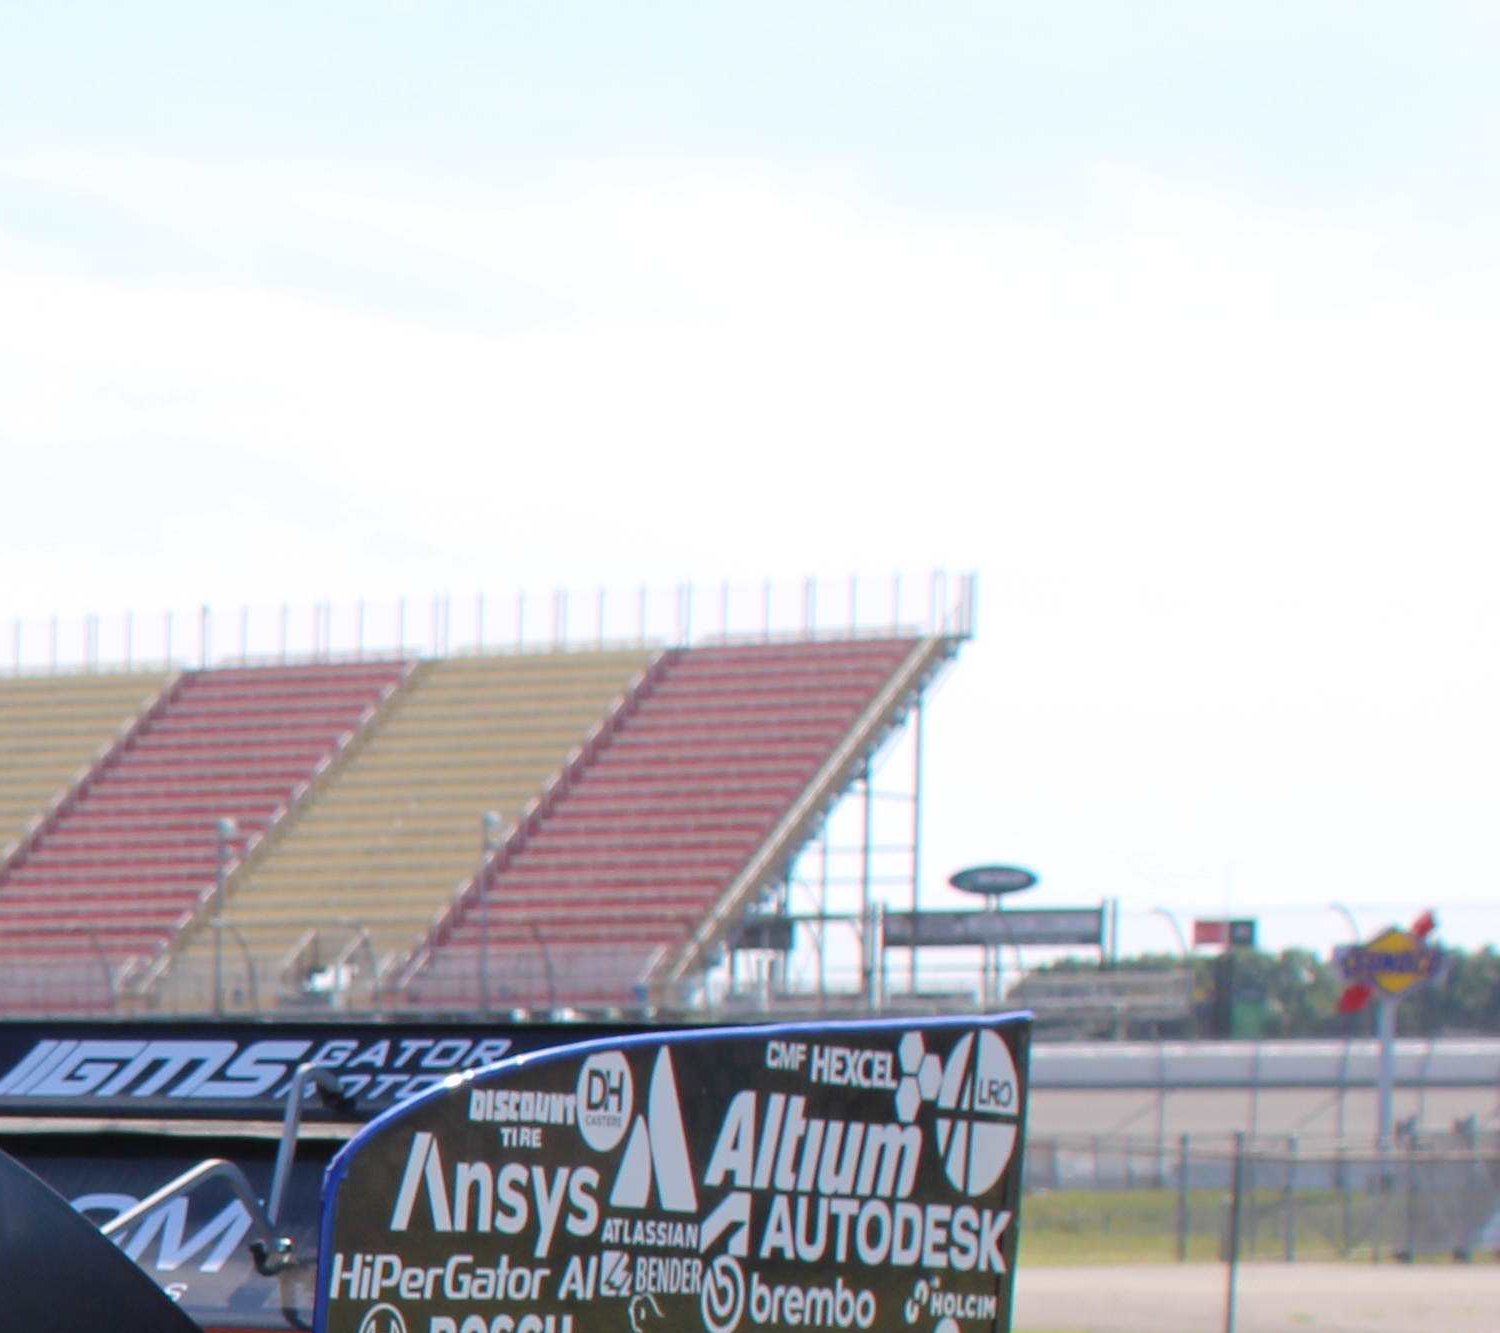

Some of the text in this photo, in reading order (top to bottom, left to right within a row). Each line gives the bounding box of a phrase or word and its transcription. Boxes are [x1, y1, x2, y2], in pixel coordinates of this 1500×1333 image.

[42, 1041, 314, 1098] GMS
[309, 1038, 512, 1071] GATOR
[766, 1041, 807, 1070] CMF
[810, 1045, 899, 1089] HEXCEL
[469, 1089, 578, 1125] DISCOUNT
[587, 1068, 624, 1113] DH
[501, 1127, 542, 1148] TIRE
[585, 1115, 621, 1129] CASTERS
[703, 1090, 923, 1199] Altium
[390, 1132, 600, 1258] Ansys
[601, 1217, 699, 1249] ATLASSIAN
[759, 1194, 1013, 1273] AUTODESK
[330, 1253, 597, 1300] HiPerGator AI
[635, 1256, 703, 1294] BENDER
[751, 1272, 876, 1329] brembo
[930, 1292, 997, 1319] HOLCIM
